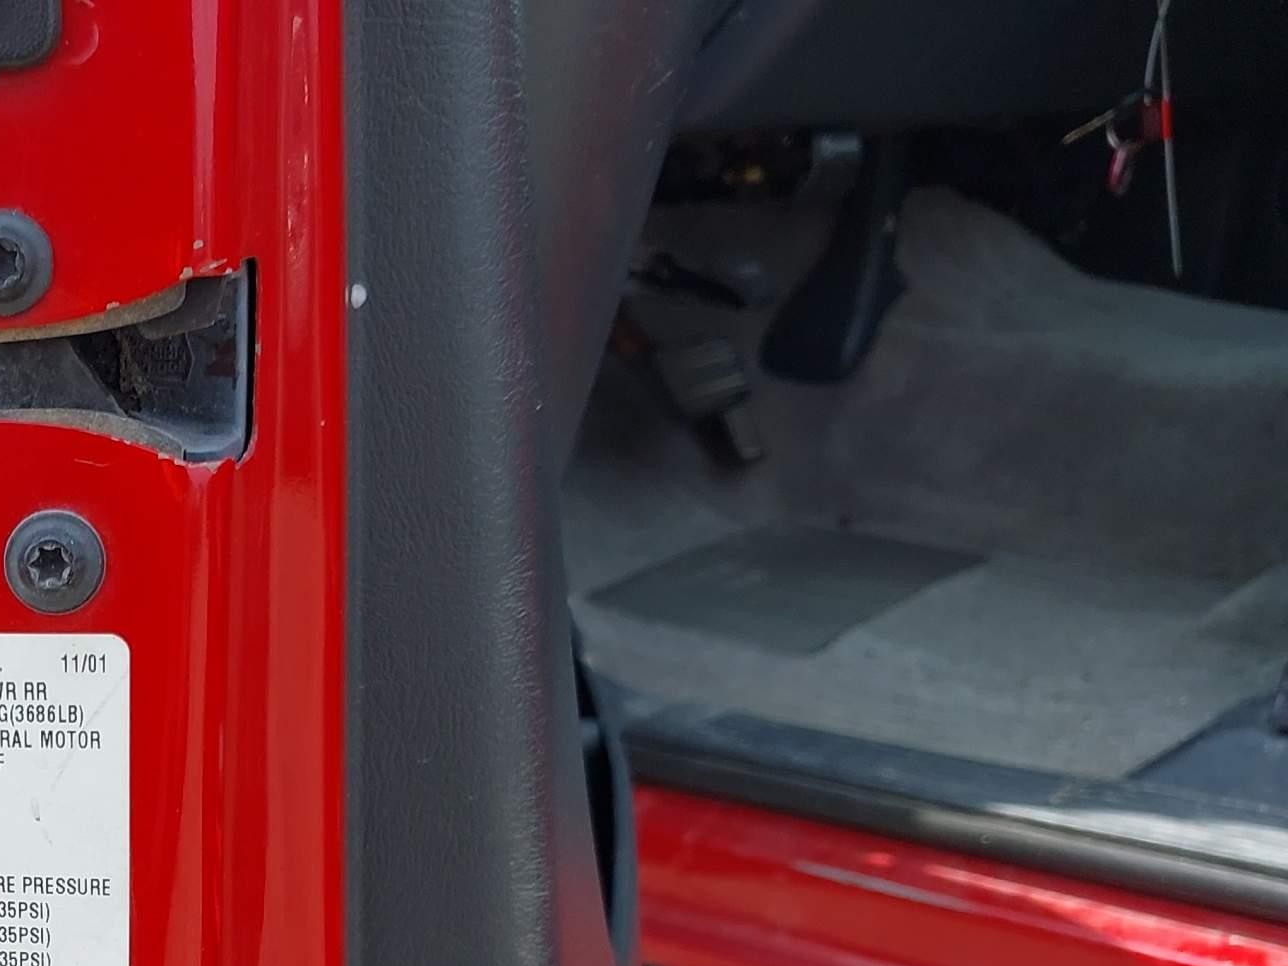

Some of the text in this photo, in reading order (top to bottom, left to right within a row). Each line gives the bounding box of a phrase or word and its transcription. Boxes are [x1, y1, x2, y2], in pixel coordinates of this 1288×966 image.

[61, 654, 107, 674] 11/01
[24, 682, 48, 701] RR
[40, 730, 101, 749] MOTOR
[22, 876, 111, 896] PRESSURE
